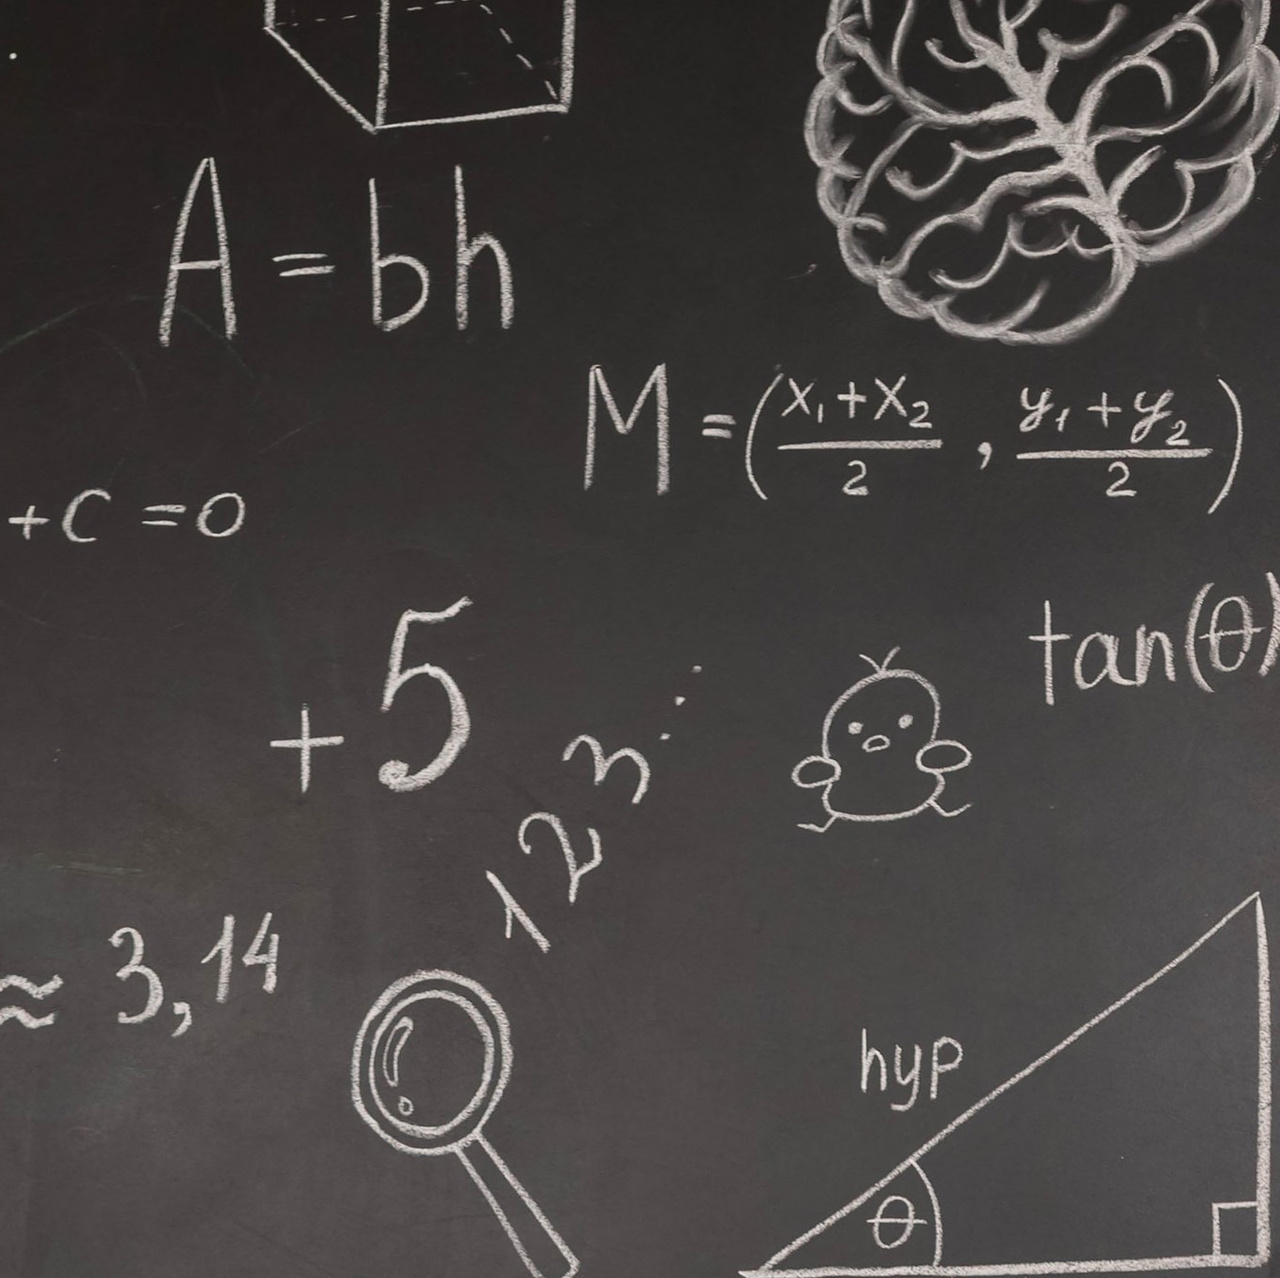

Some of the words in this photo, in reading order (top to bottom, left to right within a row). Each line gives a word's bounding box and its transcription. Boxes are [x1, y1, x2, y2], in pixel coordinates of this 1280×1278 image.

[158, 157, 237, 348] A
[582, 362, 669, 497] M
[860, 1028, 964, 1111] hyp
